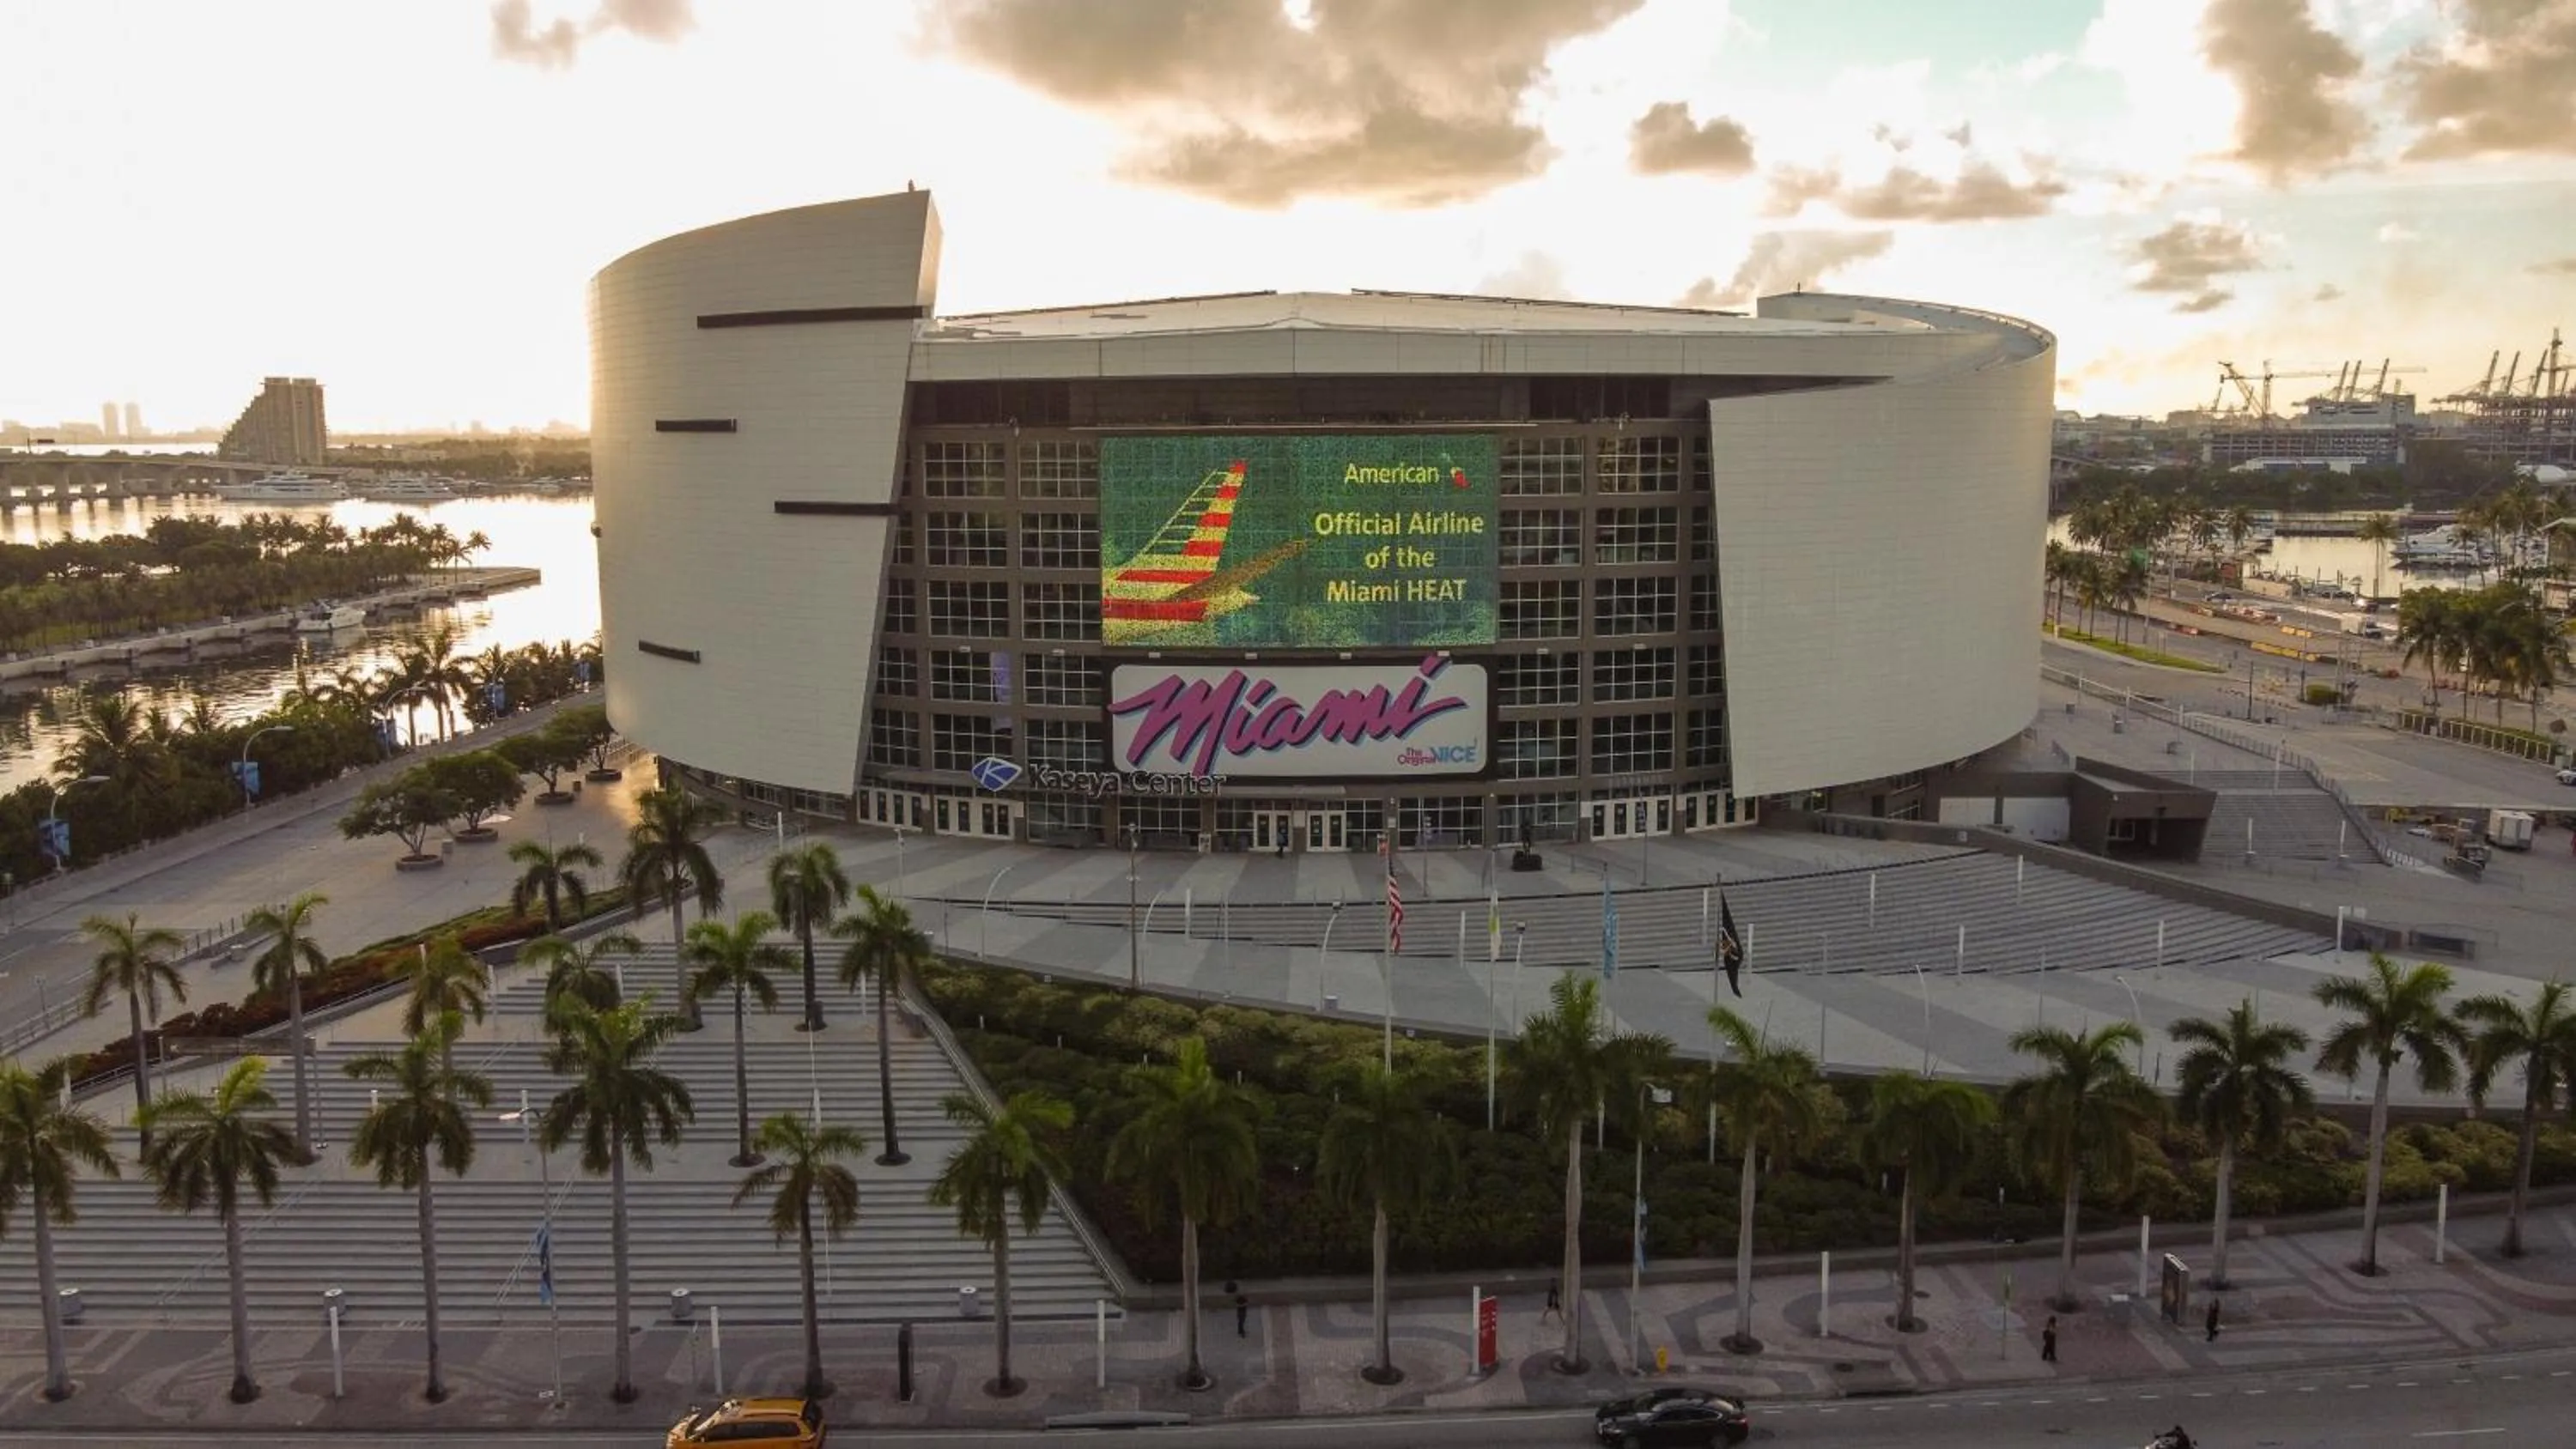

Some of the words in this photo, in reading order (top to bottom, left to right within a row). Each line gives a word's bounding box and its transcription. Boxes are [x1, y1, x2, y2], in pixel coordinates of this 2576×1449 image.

[1345, 462, 1440, 484] American
[1315, 512, 1400, 536] Official
[1408, 512, 1485, 535] Airline
[1365, 546, 1390, 568] of
[1396, 546, 1435, 568] the
[1327, 579, 1400, 602] Miami
[1407, 579, 1467, 602] HEAT
[1107, 654, 1469, 776] Miami
[1030, 763, 1122, 797] Kaseya
[1128, 769, 1227, 796] Center
